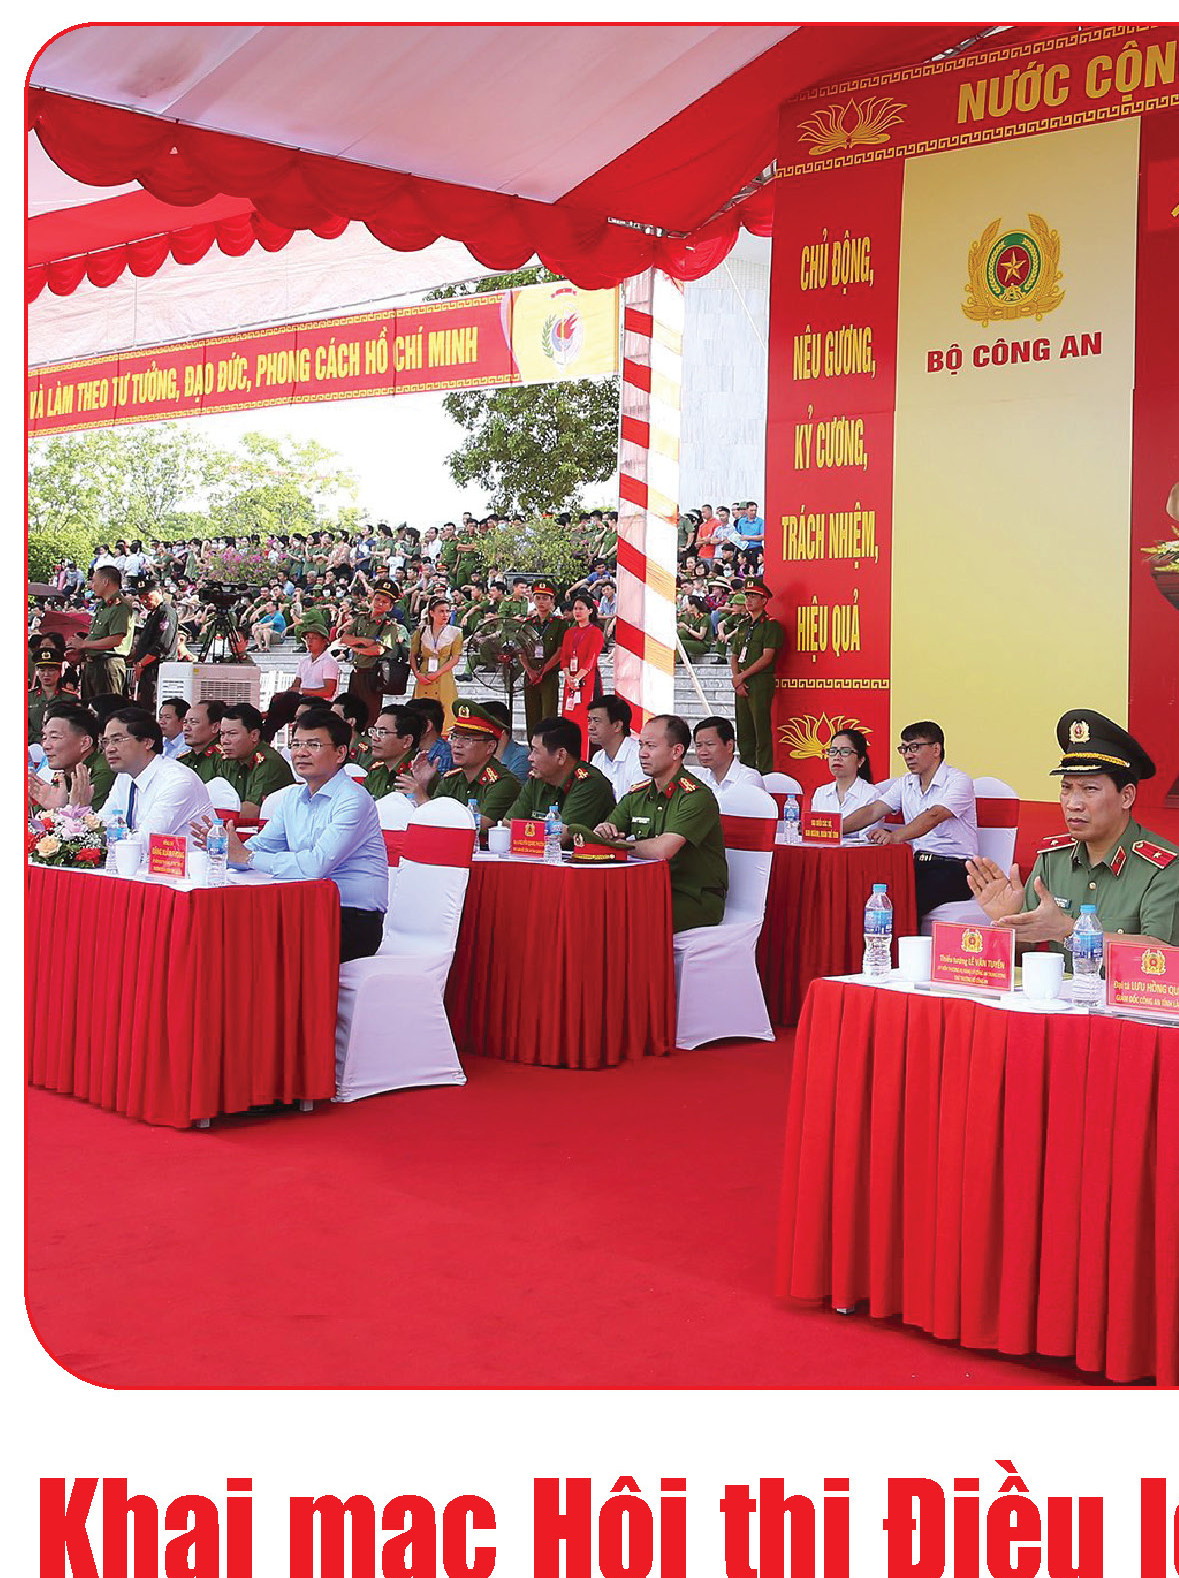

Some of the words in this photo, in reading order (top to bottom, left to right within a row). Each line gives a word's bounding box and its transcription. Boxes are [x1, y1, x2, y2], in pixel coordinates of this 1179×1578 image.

[957, 61, 1070, 124] NƯỚC
[800, 228, 829, 291] CHỦ
[831, 230, 874, 295] ĐỘNG,
[29, 384, 43, 420] VÀ
[47, 381, 74, 417] LÀM
[77, 379, 108, 412] THEO
[112, 373, 130, 406] TƯ
[132, 360, 180, 403] TƯỞNG,
[184, 362, 214, 403] ĐẠO
[217, 352, 252, 392] ĐỨC,
[256, 348, 310, 388] PHONG
[315, 337, 360, 381] CÁCH
[365, 326, 389, 375] HỒ
[395, 326, 423, 372] CHÍ
[428, 327, 479, 367] MINH
[793, 324, 822, 381] NÊU
[824, 324, 876, 378] GƯƠNG,
[927, 343, 962, 375] BỘ
[972, 338, 1050, 367] CÔNG
[1059, 331, 1102, 359] AN
[794, 404, 814, 470] KỶ
[816, 416, 868, 471] CƯƠNG,
[781, 504, 825, 561] TRÁCH
[828, 502, 879, 570] NHIỆM,
[797, 595, 829, 663] HIỆU
[831, 588, 861, 657] QUẢ
